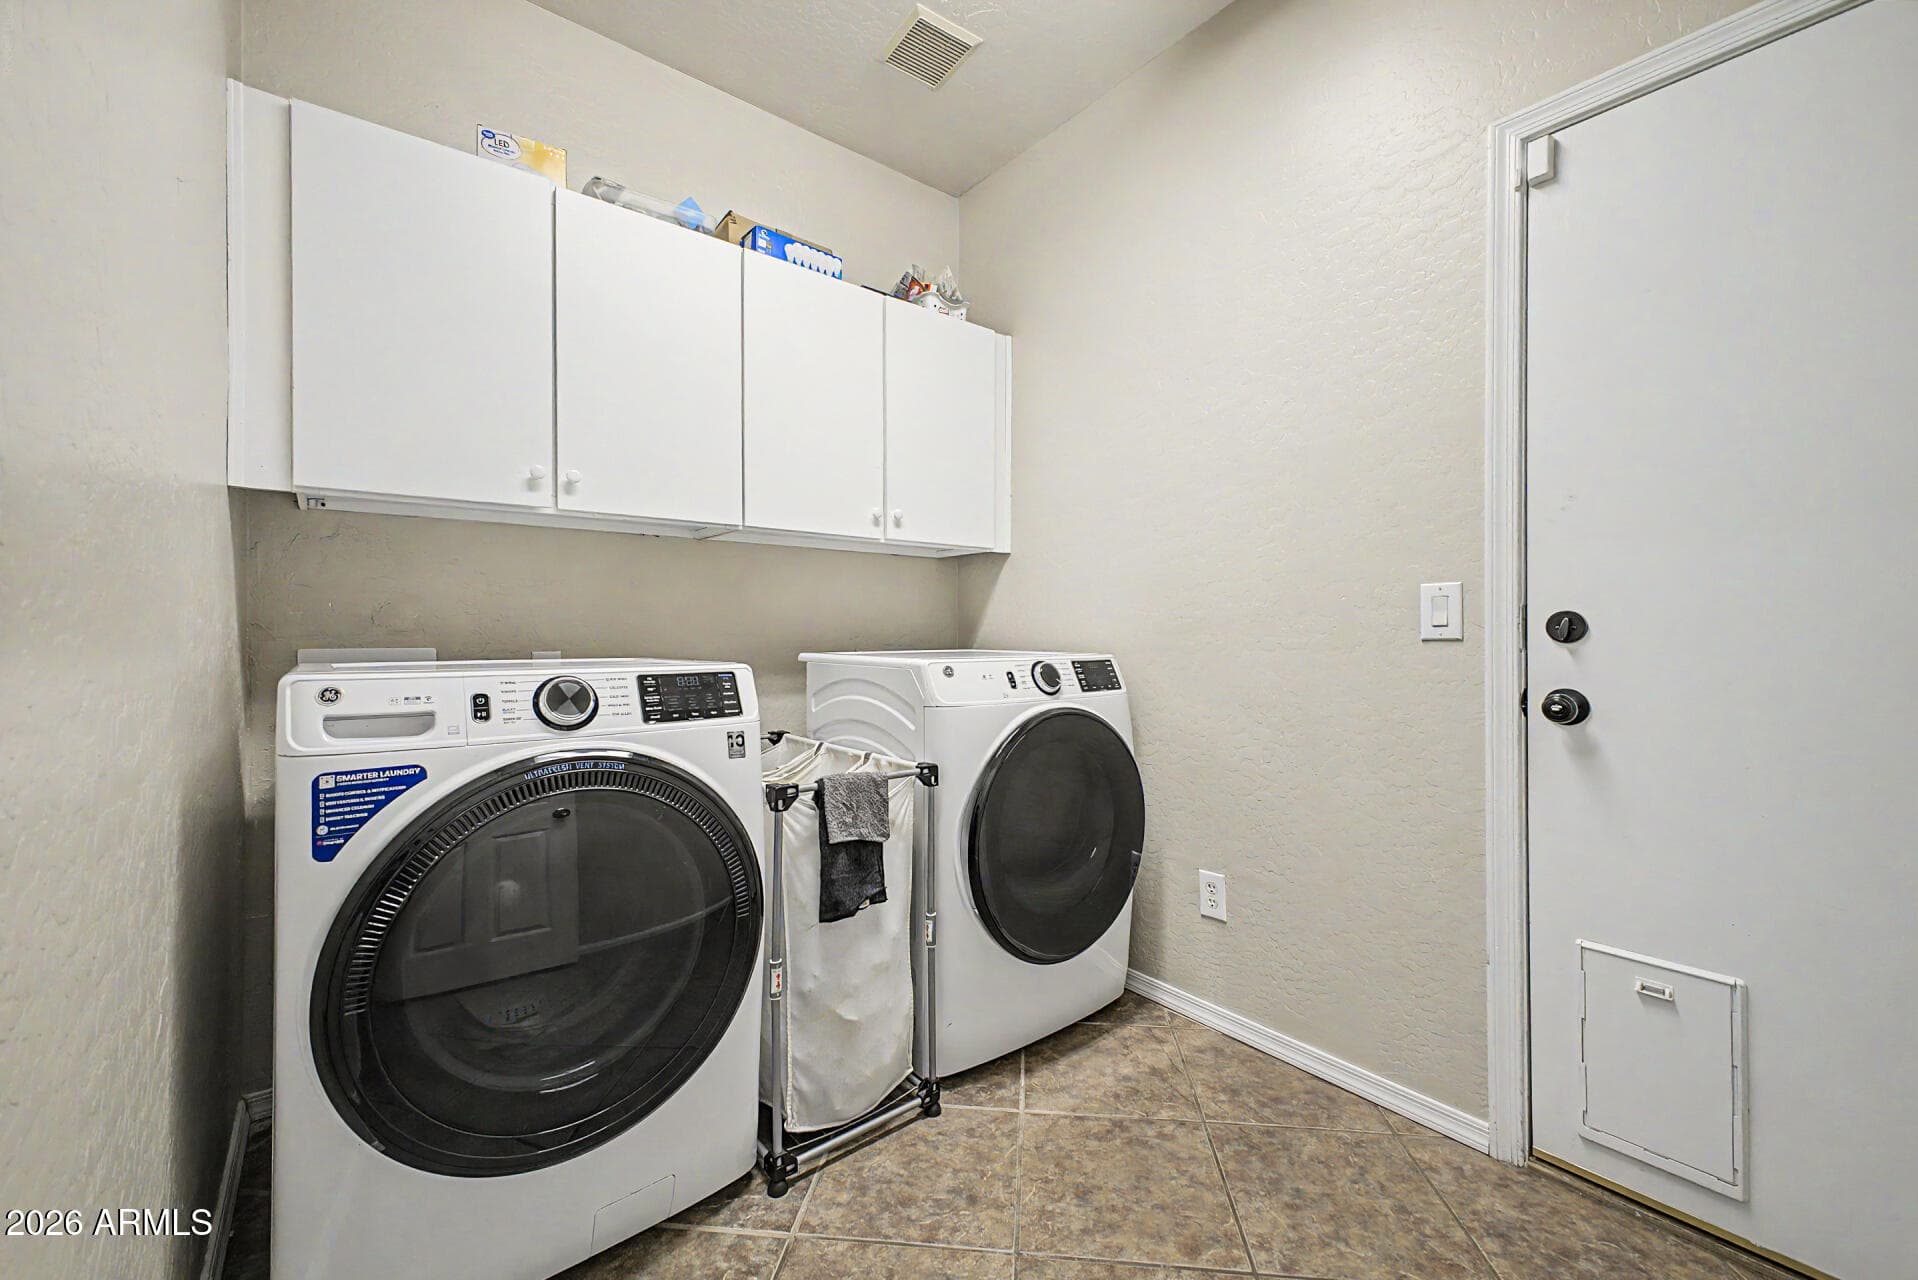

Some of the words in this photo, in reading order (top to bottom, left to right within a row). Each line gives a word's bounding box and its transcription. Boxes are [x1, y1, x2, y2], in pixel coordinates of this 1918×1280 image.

[494, 138, 510, 149] LED
[575, 761, 594, 770] VENT
[336, 772, 379, 782] SMARTER
[380, 767, 421, 777] LAUNDRY
